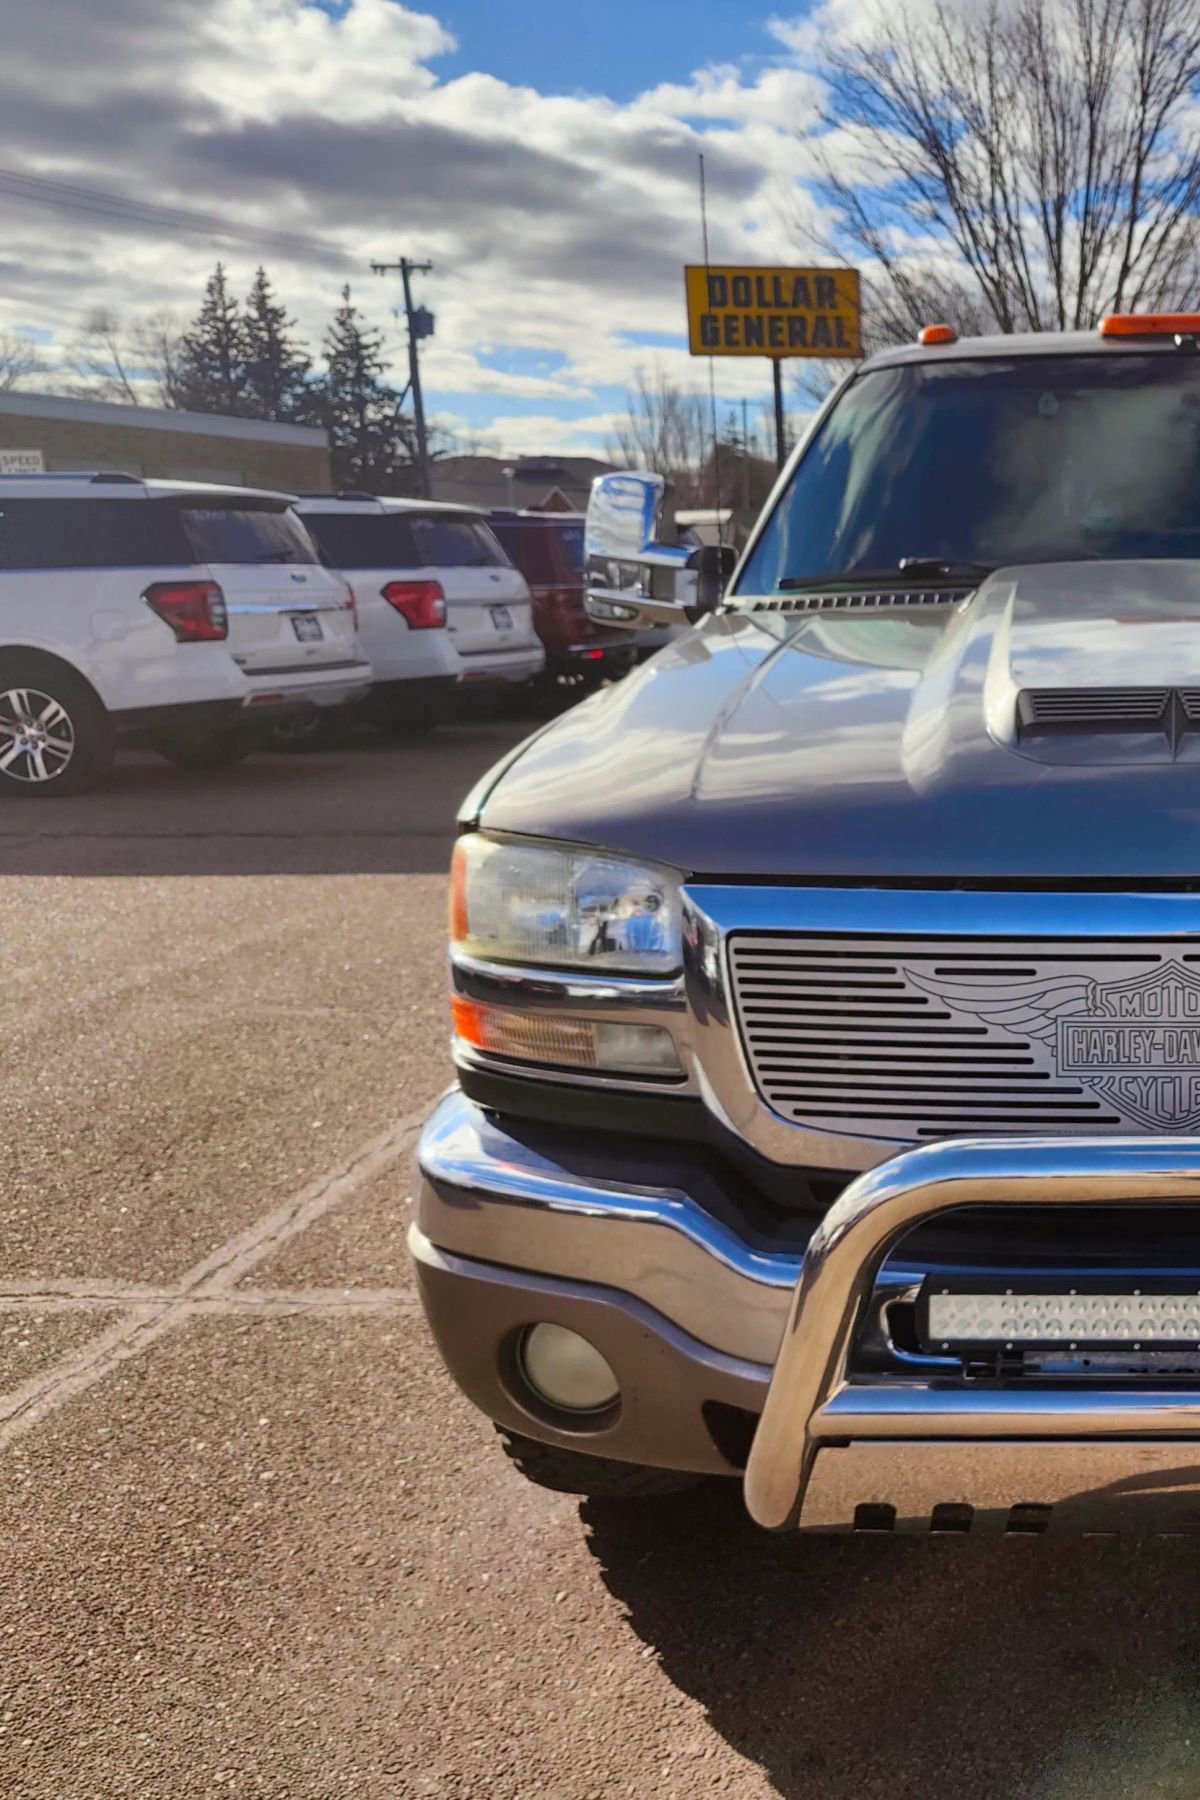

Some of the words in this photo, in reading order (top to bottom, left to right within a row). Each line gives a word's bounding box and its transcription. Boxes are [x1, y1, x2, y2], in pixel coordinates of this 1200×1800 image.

[708, 275, 837, 309] DOLLAR
[701, 314, 850, 348] GENERAL
[2, 455, 40, 465] SPEED
